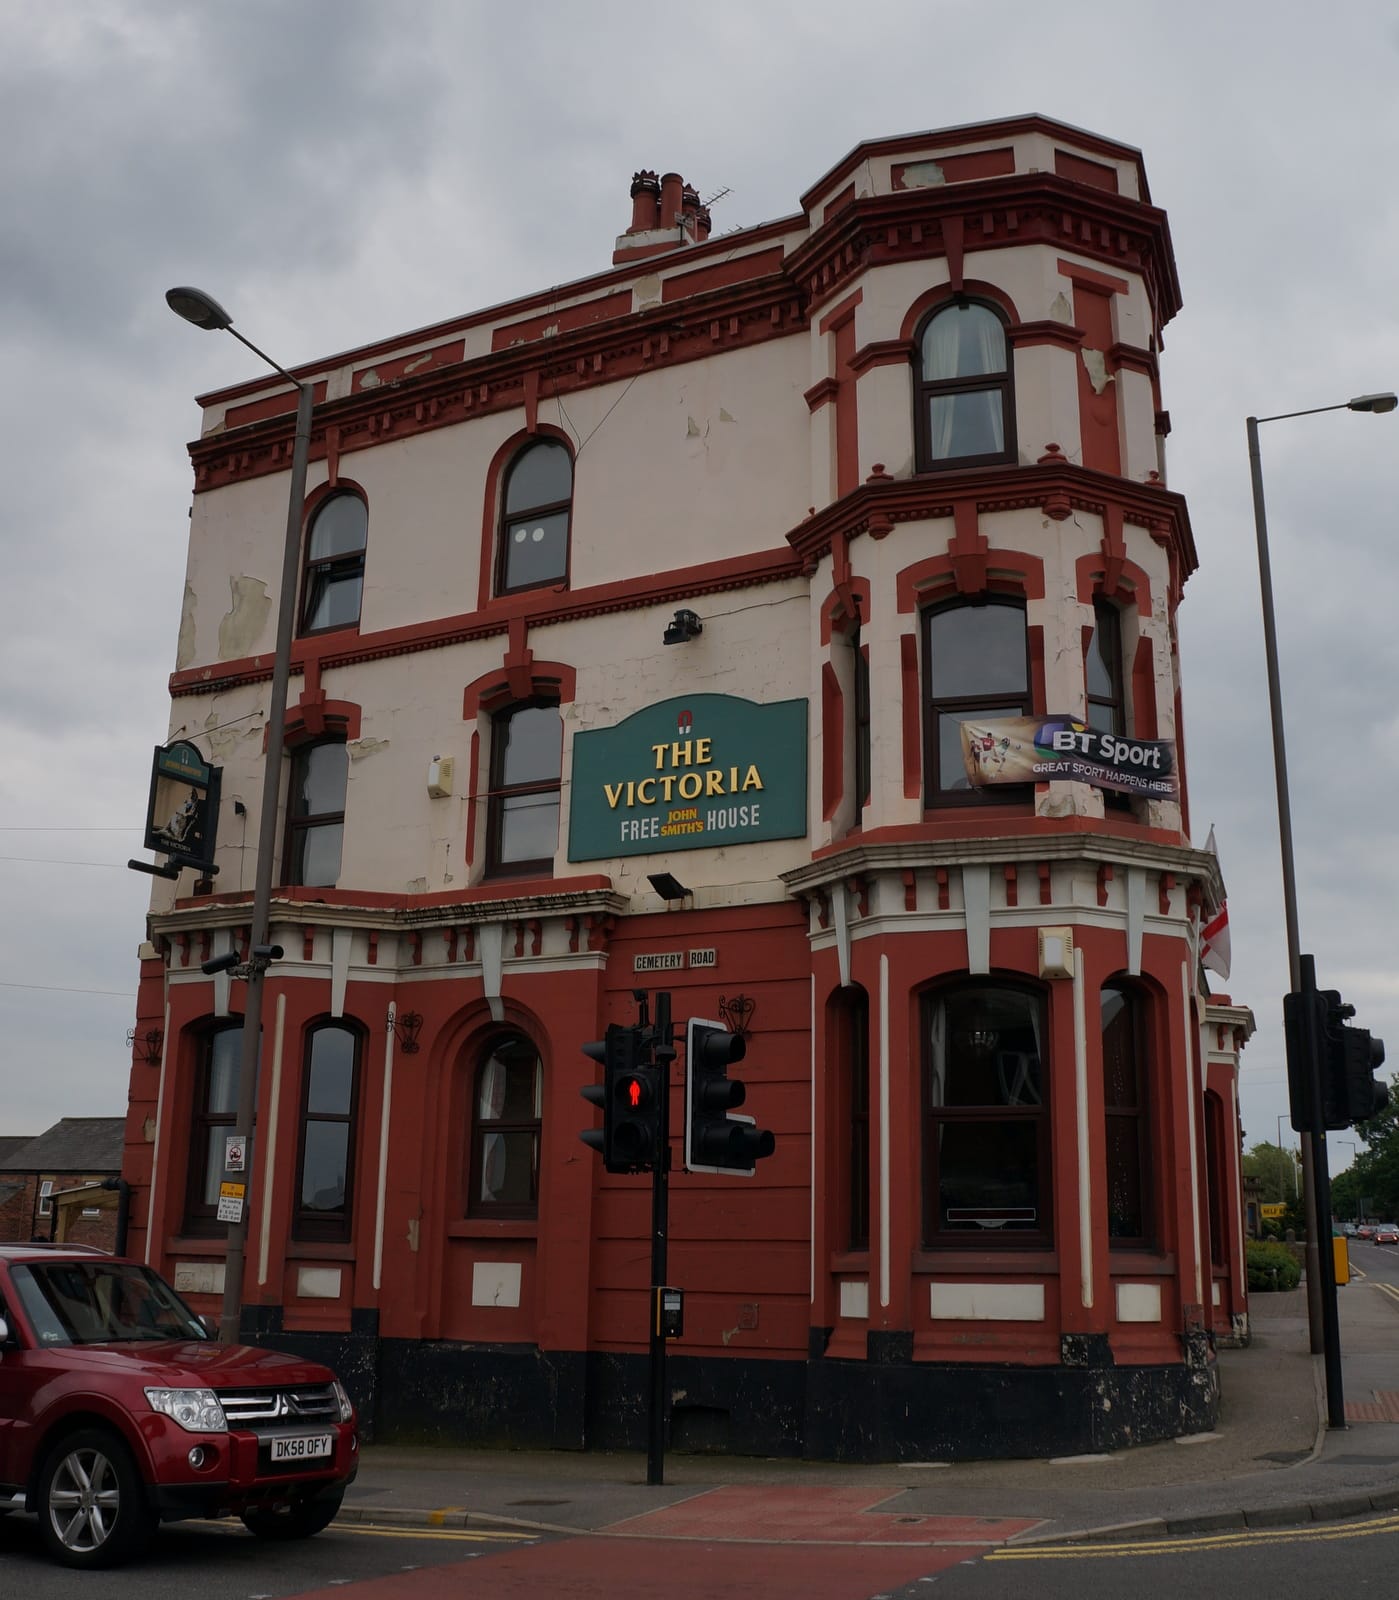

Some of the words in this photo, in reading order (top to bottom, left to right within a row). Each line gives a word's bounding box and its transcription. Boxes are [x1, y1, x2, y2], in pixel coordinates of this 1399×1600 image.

[652, 737, 713, 770] THE
[1053, 730, 1096, 753] BT
[1100, 735, 1161, 769] Sport
[604, 764, 765, 809] VICTORIA
[1032, 762, 1070, 773] GREAT
[1072, 762, 1105, 778] SPORT
[1106, 769, 1147, 787] HAPPENS
[1148, 780, 1174, 793] HERE
[621, 816, 660, 842] FREE
[660, 820, 704, 837] SMITH'S
[707, 804, 760, 831] HOUSE
[667, 808, 698, 823] JOHN
[636, 954, 682, 969] CEMETERY
[691, 951, 714, 965] ROAD
[277, 1440, 304, 1457] DK58
[307, 1438, 327, 1454] OFY
